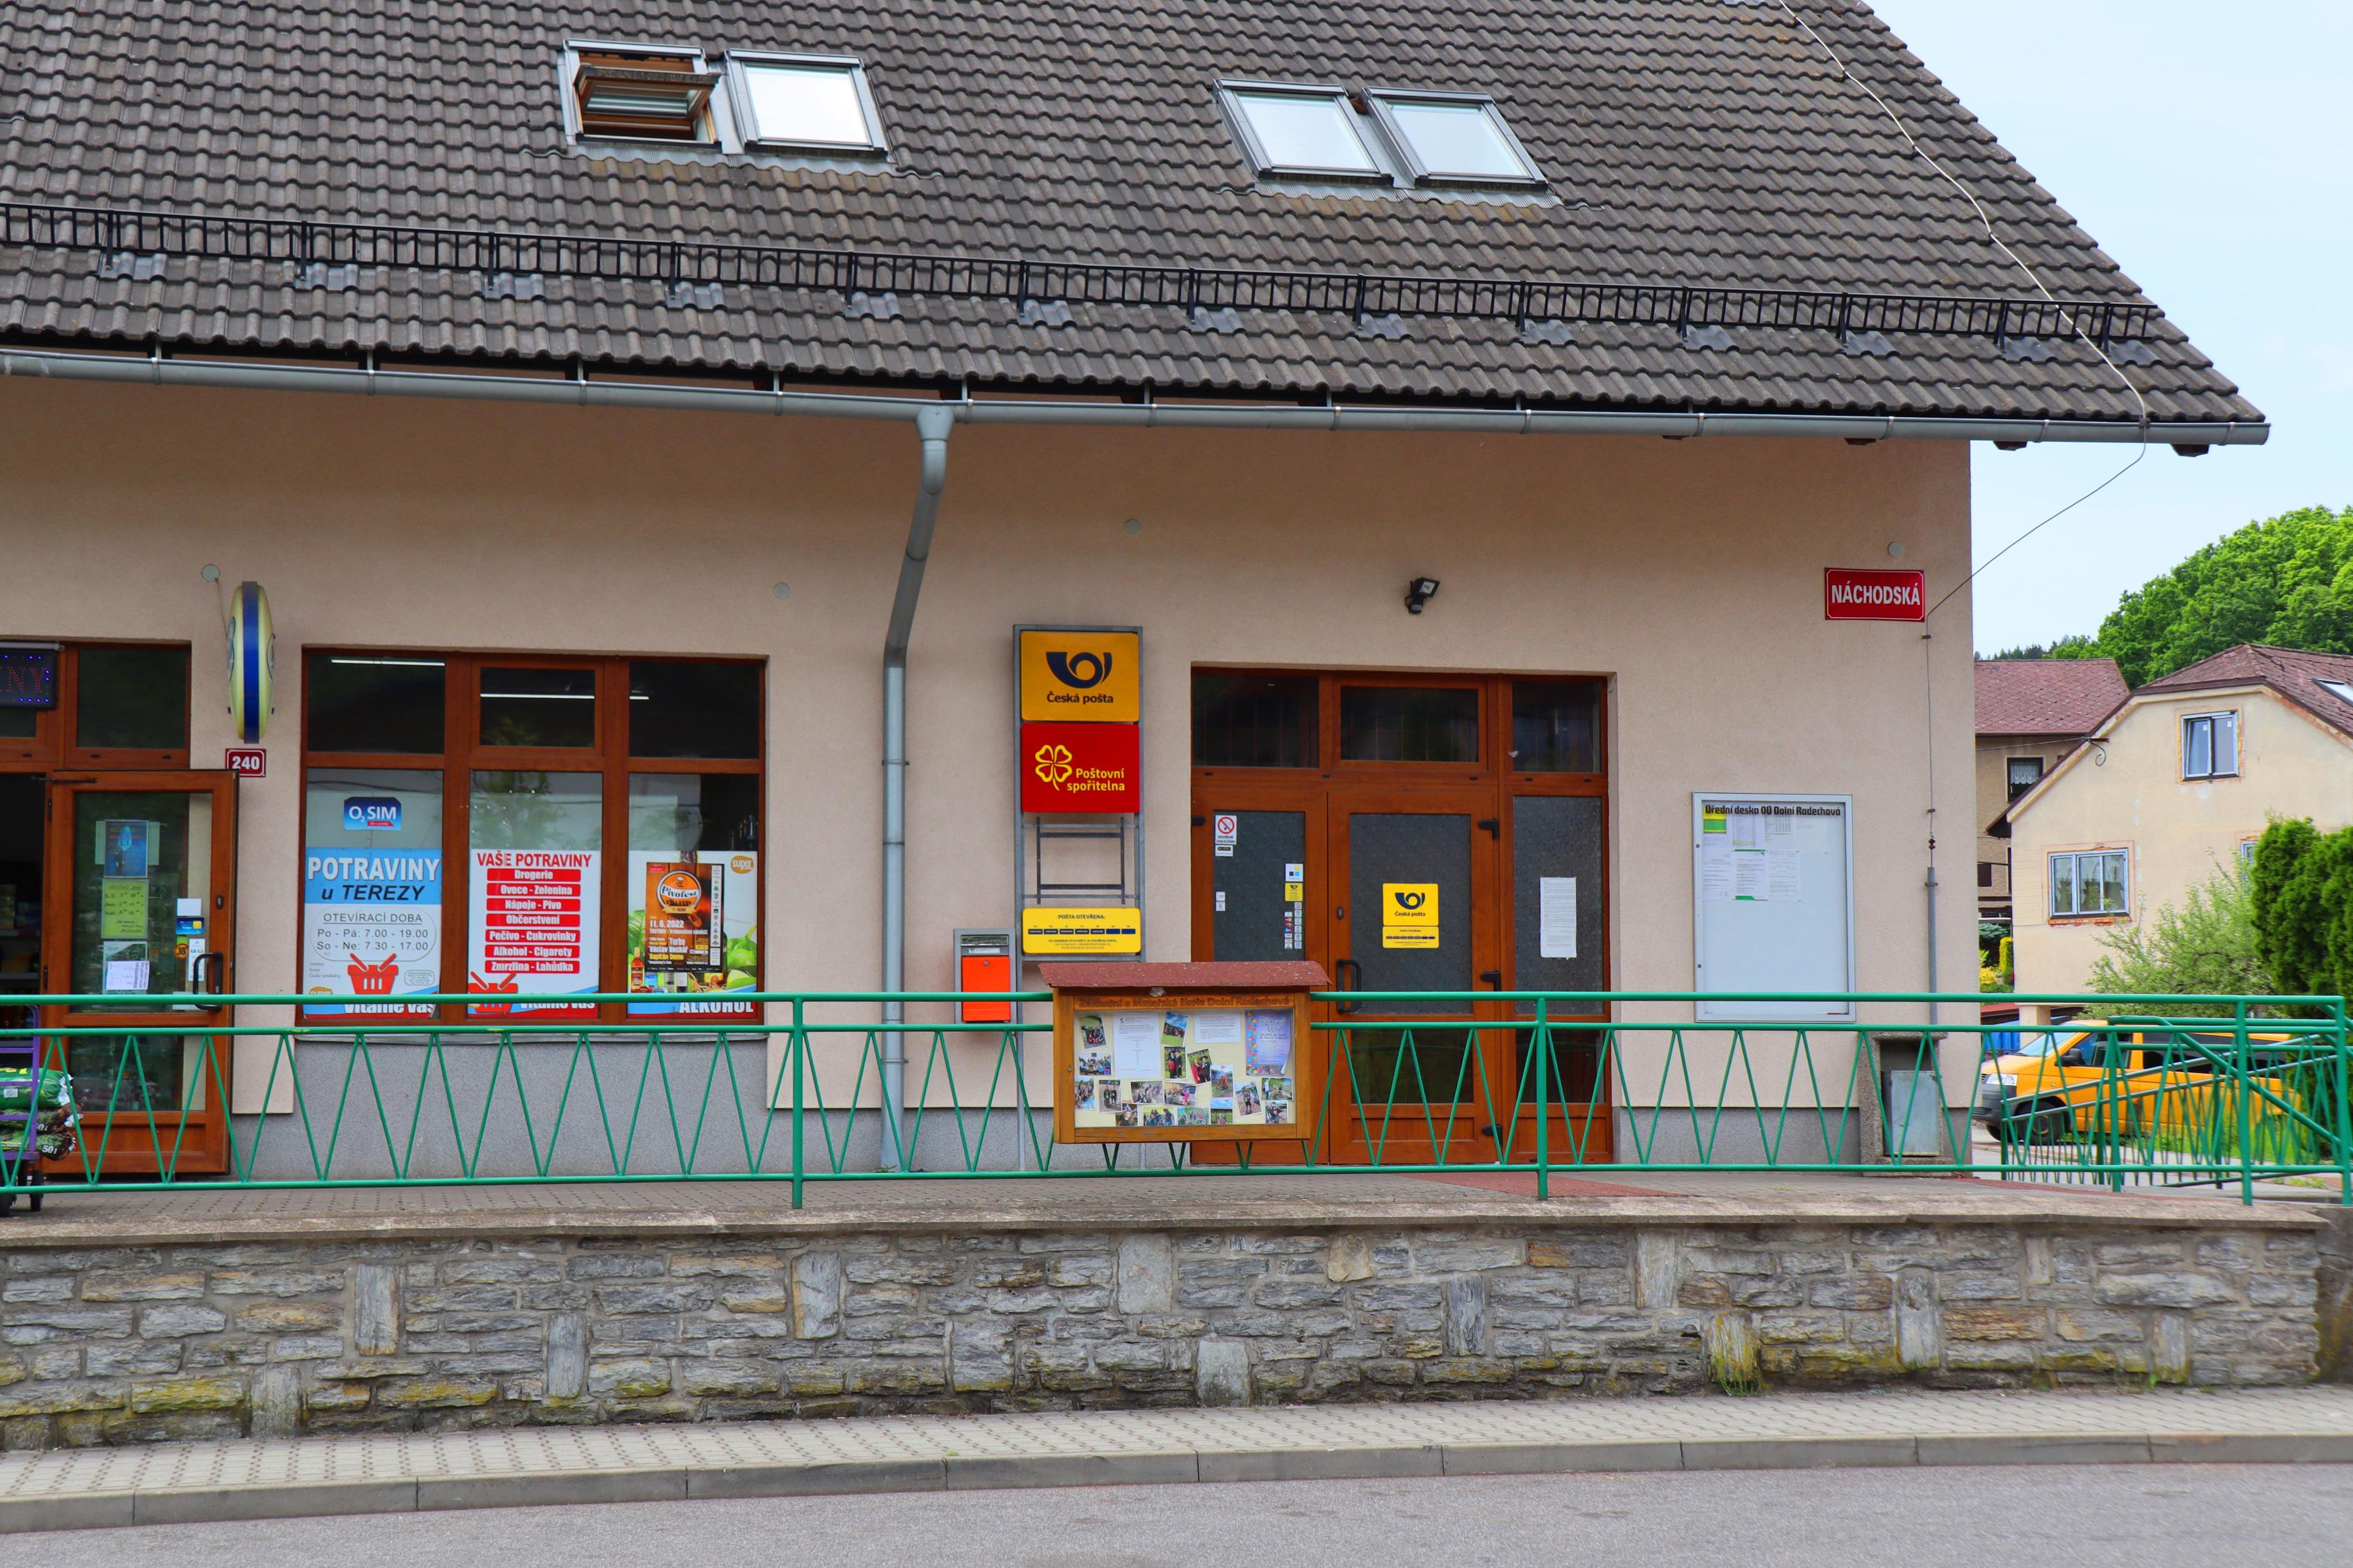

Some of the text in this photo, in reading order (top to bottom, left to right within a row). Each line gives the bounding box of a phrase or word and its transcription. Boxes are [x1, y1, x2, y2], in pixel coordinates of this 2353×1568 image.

[1831, 580, 1921, 605] NÁCHODSKÁ
[0, 666, 47, 693] NY
[1046, 691, 1114, 705] Česká pošta
[232, 756, 260, 770] 240
[1075, 768, 1125, 779] Poštovní
[1066, 780, 1125, 793] spořitelna
[367, 806, 396, 820] SIM
[1705, 804, 1732, 815] Úřední
[1735, 805, 1759, 815] deska
[1774, 806, 1795, 815] Dolní
[1796, 806, 1841, 816] Radechová
[477, 850, 592, 868] VAŠE POTRAVINY
[308, 857, 441, 881] POTRAVINY
[514, 869, 554, 880] Drogerie
[322, 885, 425, 900] u TEREZY
[501, 885, 528, 895] Ovoce
[534, 885, 572, 895] Zelenina
[662, 885, 696, 898] Pivofest
[505, 899, 536, 910] Nápoje
[542, 900, 562, 910] Pivo
[324, 912, 422, 922] OTEVÍRACÍ DOBA
[506, 914, 561, 925] Občerstvení
[666, 920, 685, 928] 2022
[318, 929, 331, 938] Po
[344, 929, 361, 938] Pá:
[365, 929, 388, 938] 7.00
[400, 929, 428, 938] 19.00
[489, 930, 519, 940] Pečivo
[526, 931, 576, 942] Cukrovinky
[317, 942, 331, 950] So
[342, 942, 361, 950] Ne:
[365, 942, 388, 950] 7.30
[400, 942, 428, 950] 17.00
[494, 946, 527, 956] Alkohol
[534, 946, 572, 958] Cigarety
[491, 961, 529, 971] Zmrzlina
[536, 961, 574, 972] Lahůdka
